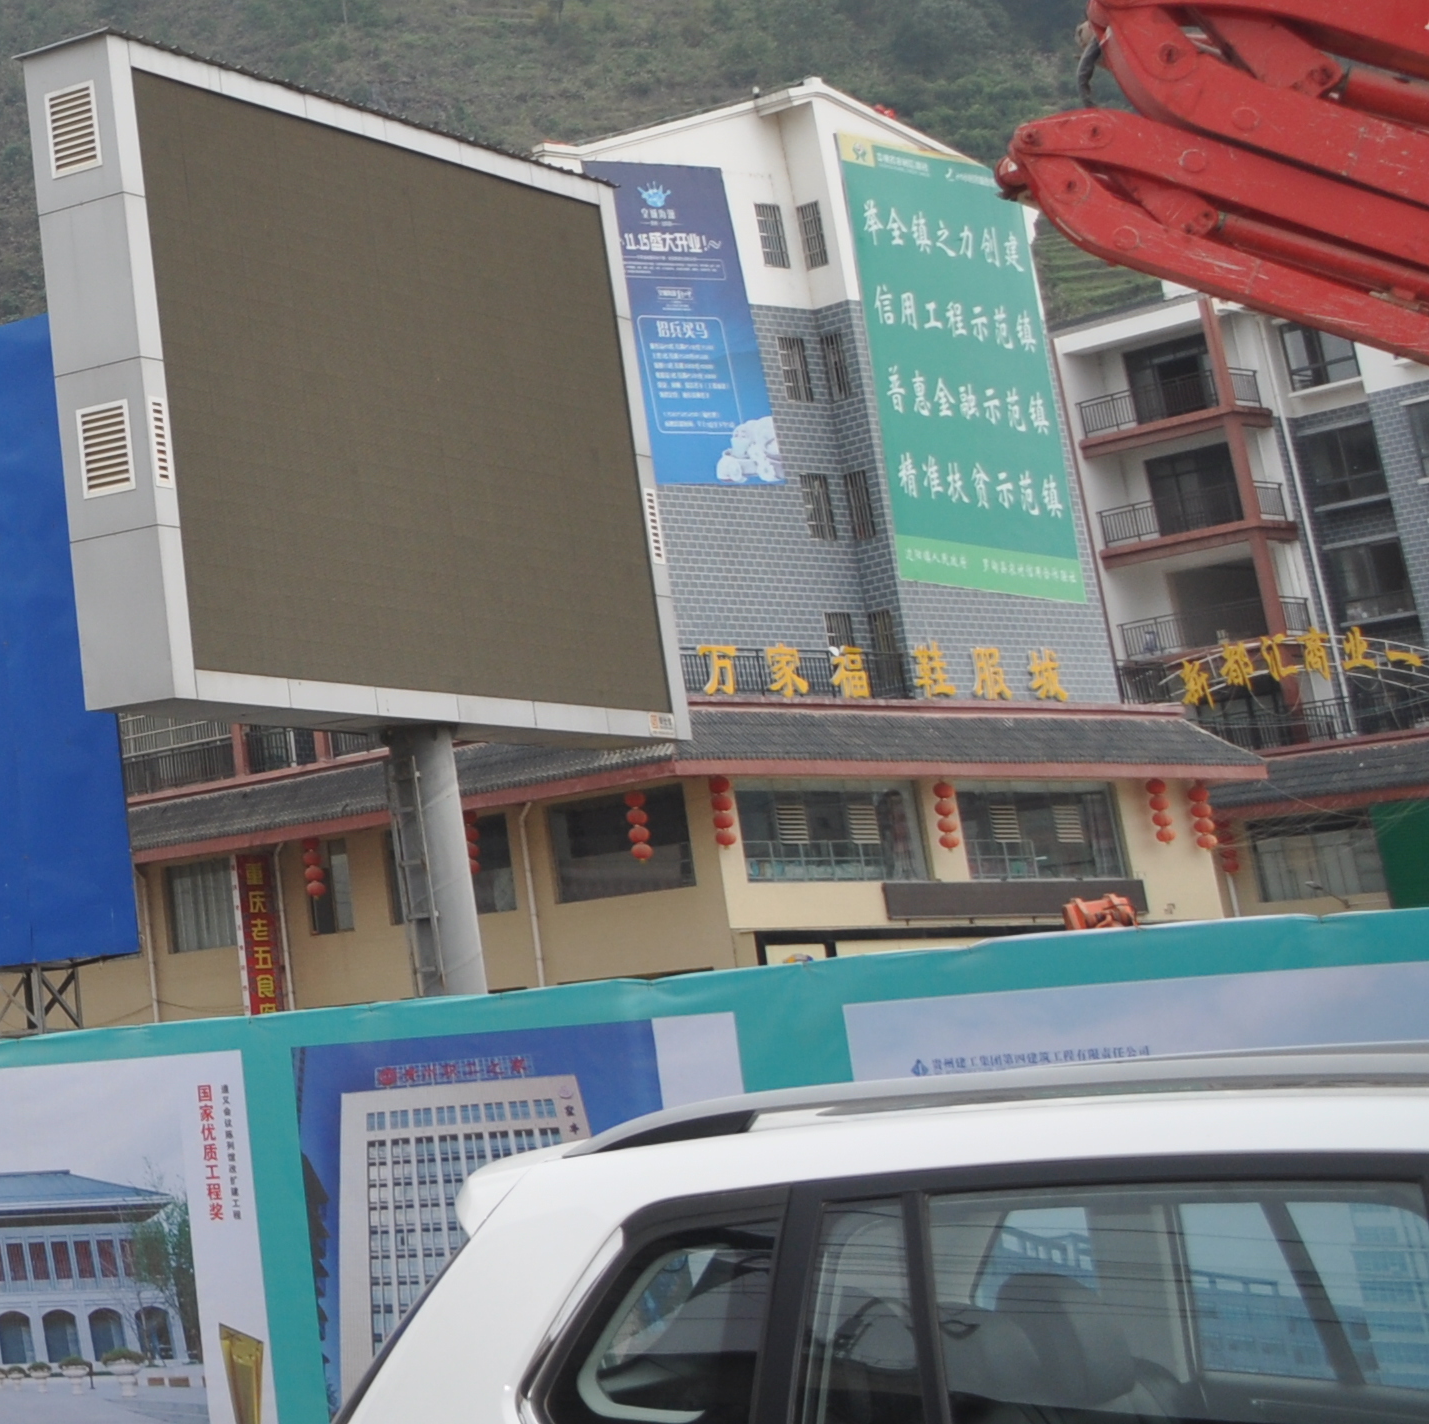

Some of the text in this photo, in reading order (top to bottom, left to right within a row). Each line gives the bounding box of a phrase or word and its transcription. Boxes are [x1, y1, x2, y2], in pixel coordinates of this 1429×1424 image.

[863, 199, 1024, 272] 举全镇之力创建
[874, 284, 1036, 353] 信用工程示范镇
[886, 366, 1049, 434] 普惠金融示范镇
[898, 452, 1063, 518] 精准扶贫示范镇
[197, 1084, 224, 1221] 国家优质工程奖
